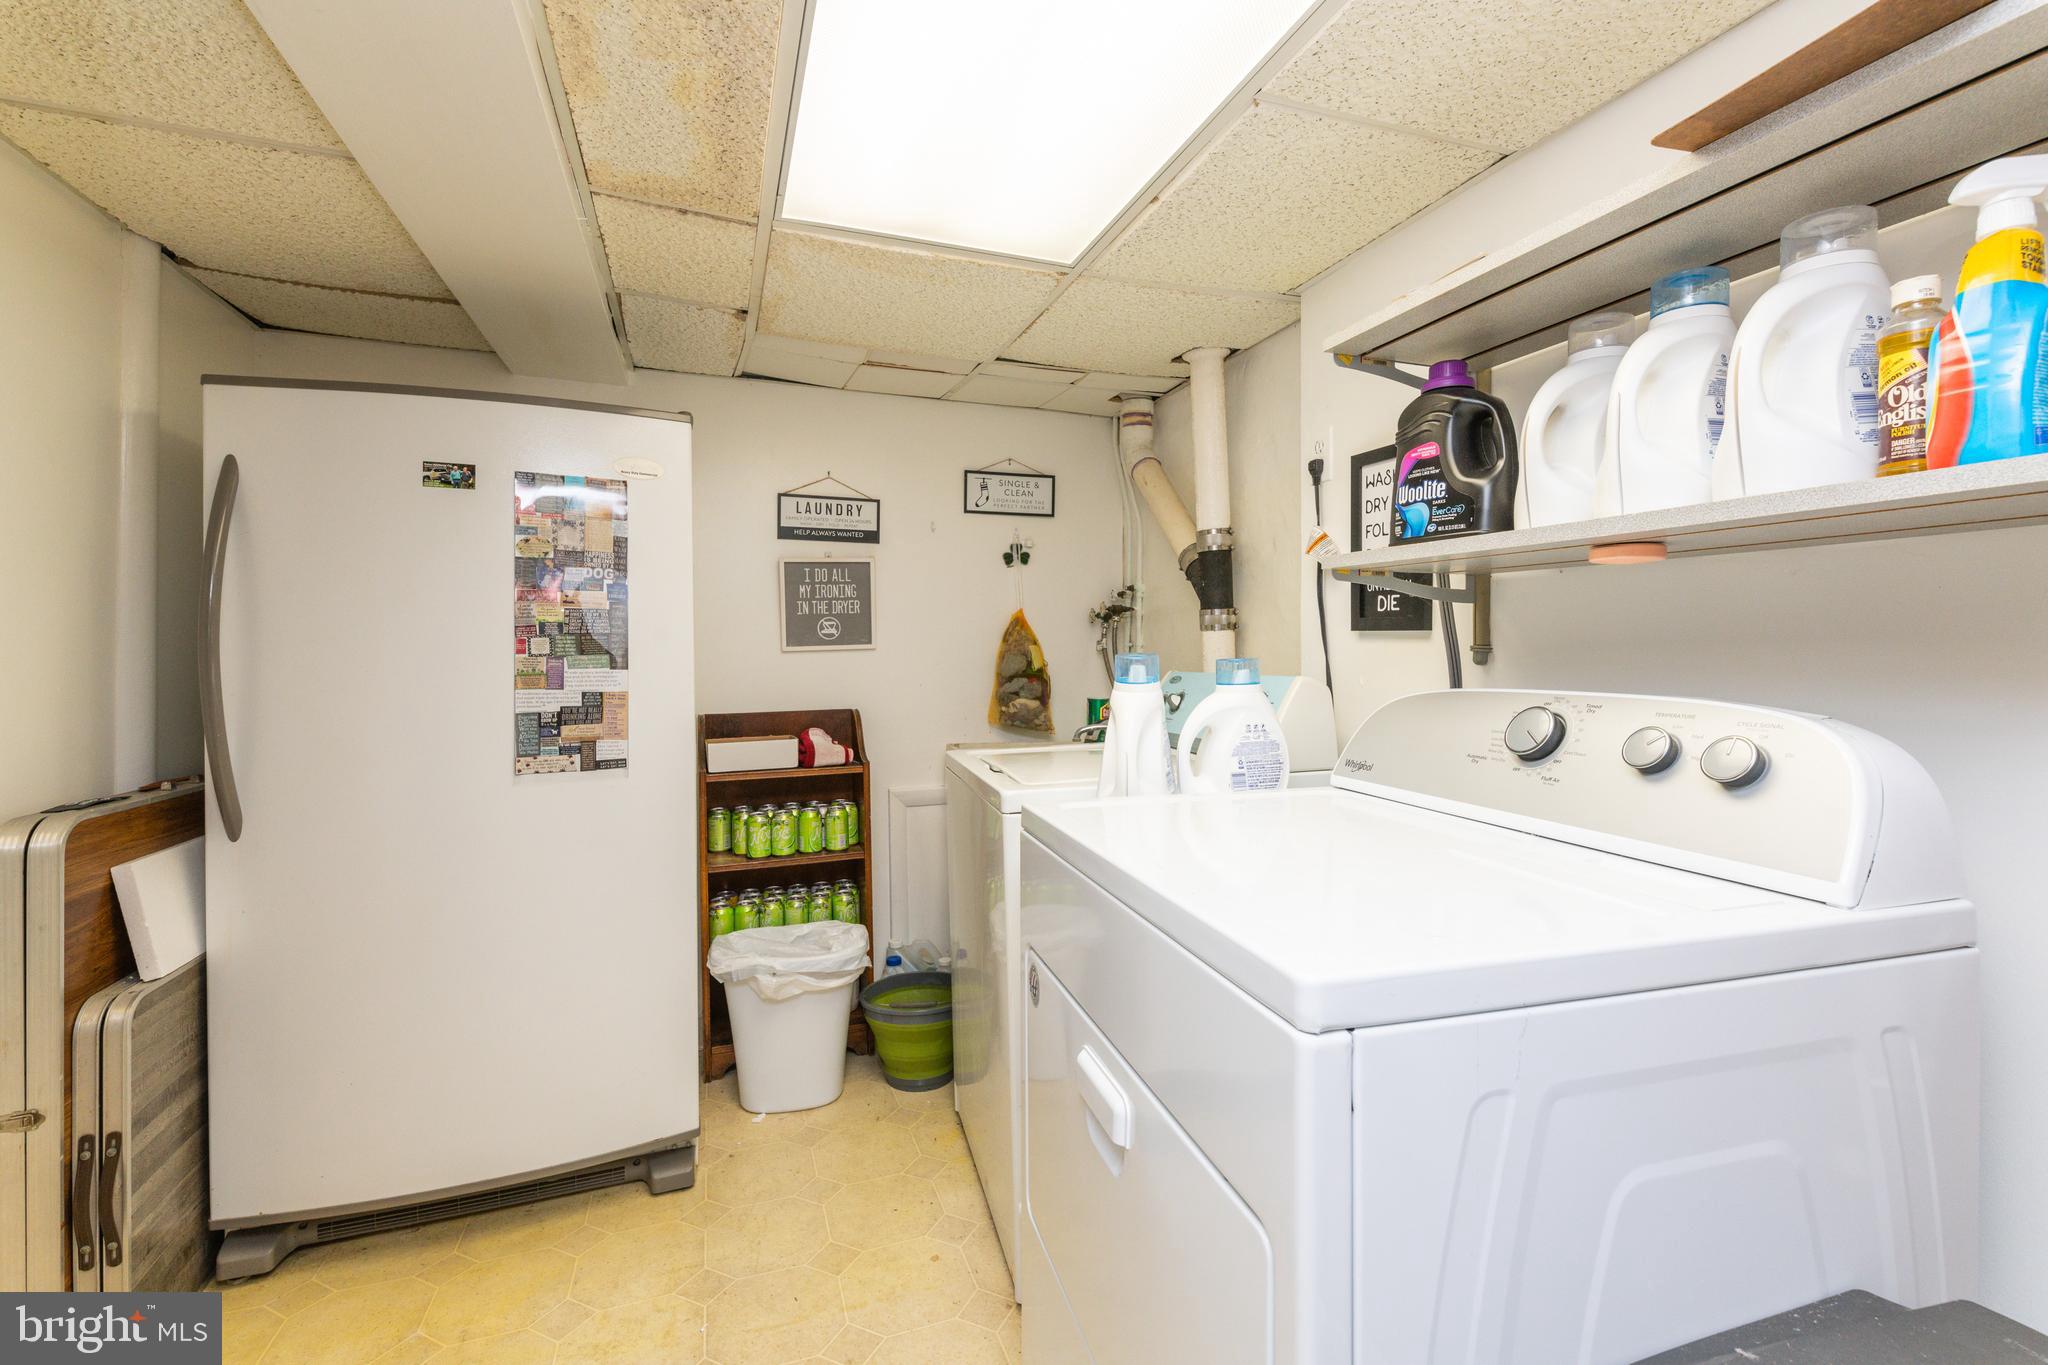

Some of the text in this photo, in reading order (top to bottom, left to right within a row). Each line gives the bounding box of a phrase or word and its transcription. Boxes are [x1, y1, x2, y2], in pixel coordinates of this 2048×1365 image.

[1887, 382, 1926, 409] Old
[1878, 403, 1926, 429] Englis
[998, 479, 1040, 489] SINGLE &
[1003, 488, 1034, 497] CLEAN
[1398, 480, 1446, 505] Woolite
[796, 501, 863, 517] LAUNDRY
[1365, 496, 1389, 514] DRY
[1365, 522, 1390, 538] FOL
[585, 567, 614, 579] DOG
[803, 567, 852, 583] I DO ALL
[799, 583, 857, 599] MY IRONING
[796, 600, 860, 615] IN THE DRYER
[1377, 594, 1400, 612] DIE
[1345, 758, 1374, 773] Whirlpool
